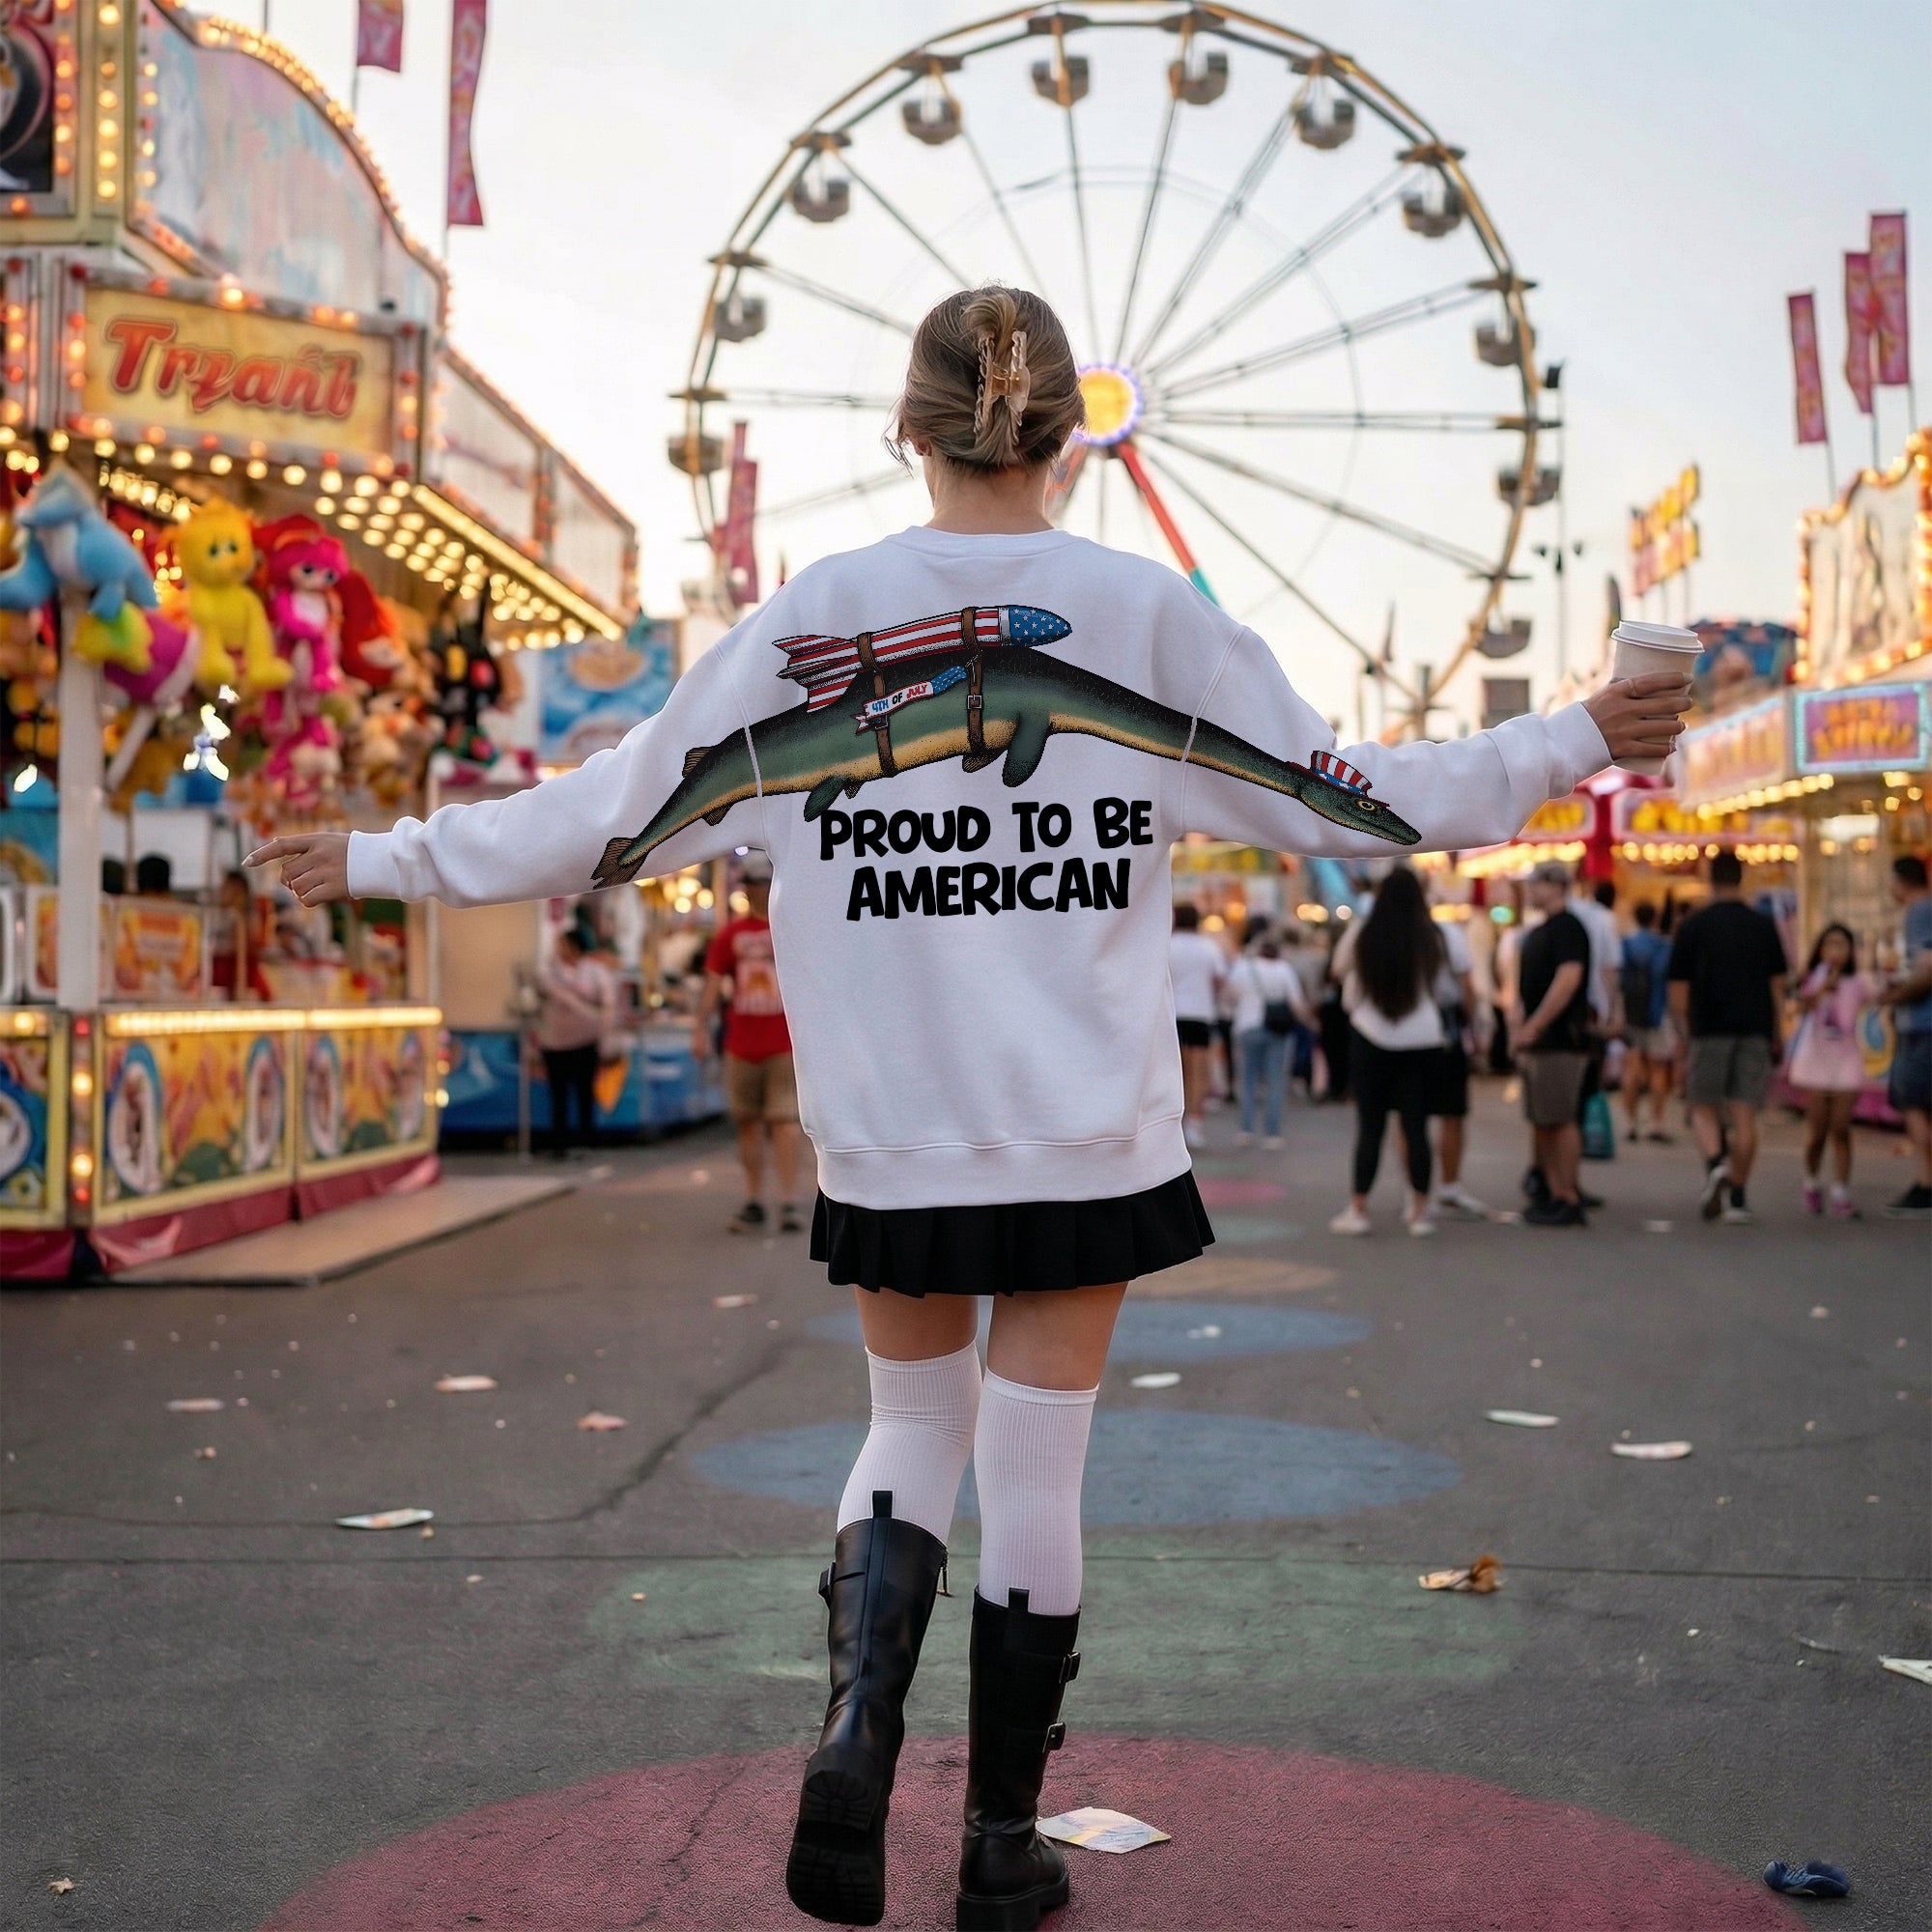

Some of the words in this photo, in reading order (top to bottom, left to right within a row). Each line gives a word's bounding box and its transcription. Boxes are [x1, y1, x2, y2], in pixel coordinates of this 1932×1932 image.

[871, 698, 889, 713] 4TH
[892, 692, 903, 705] OF
[906, 684, 927, 698] JULY
[819, 806, 991, 861] PROUD
[1012, 802, 1072, 852] TO
[1093, 797, 1153, 848] BE
[846, 858, 1131, 922] AMERICAN
